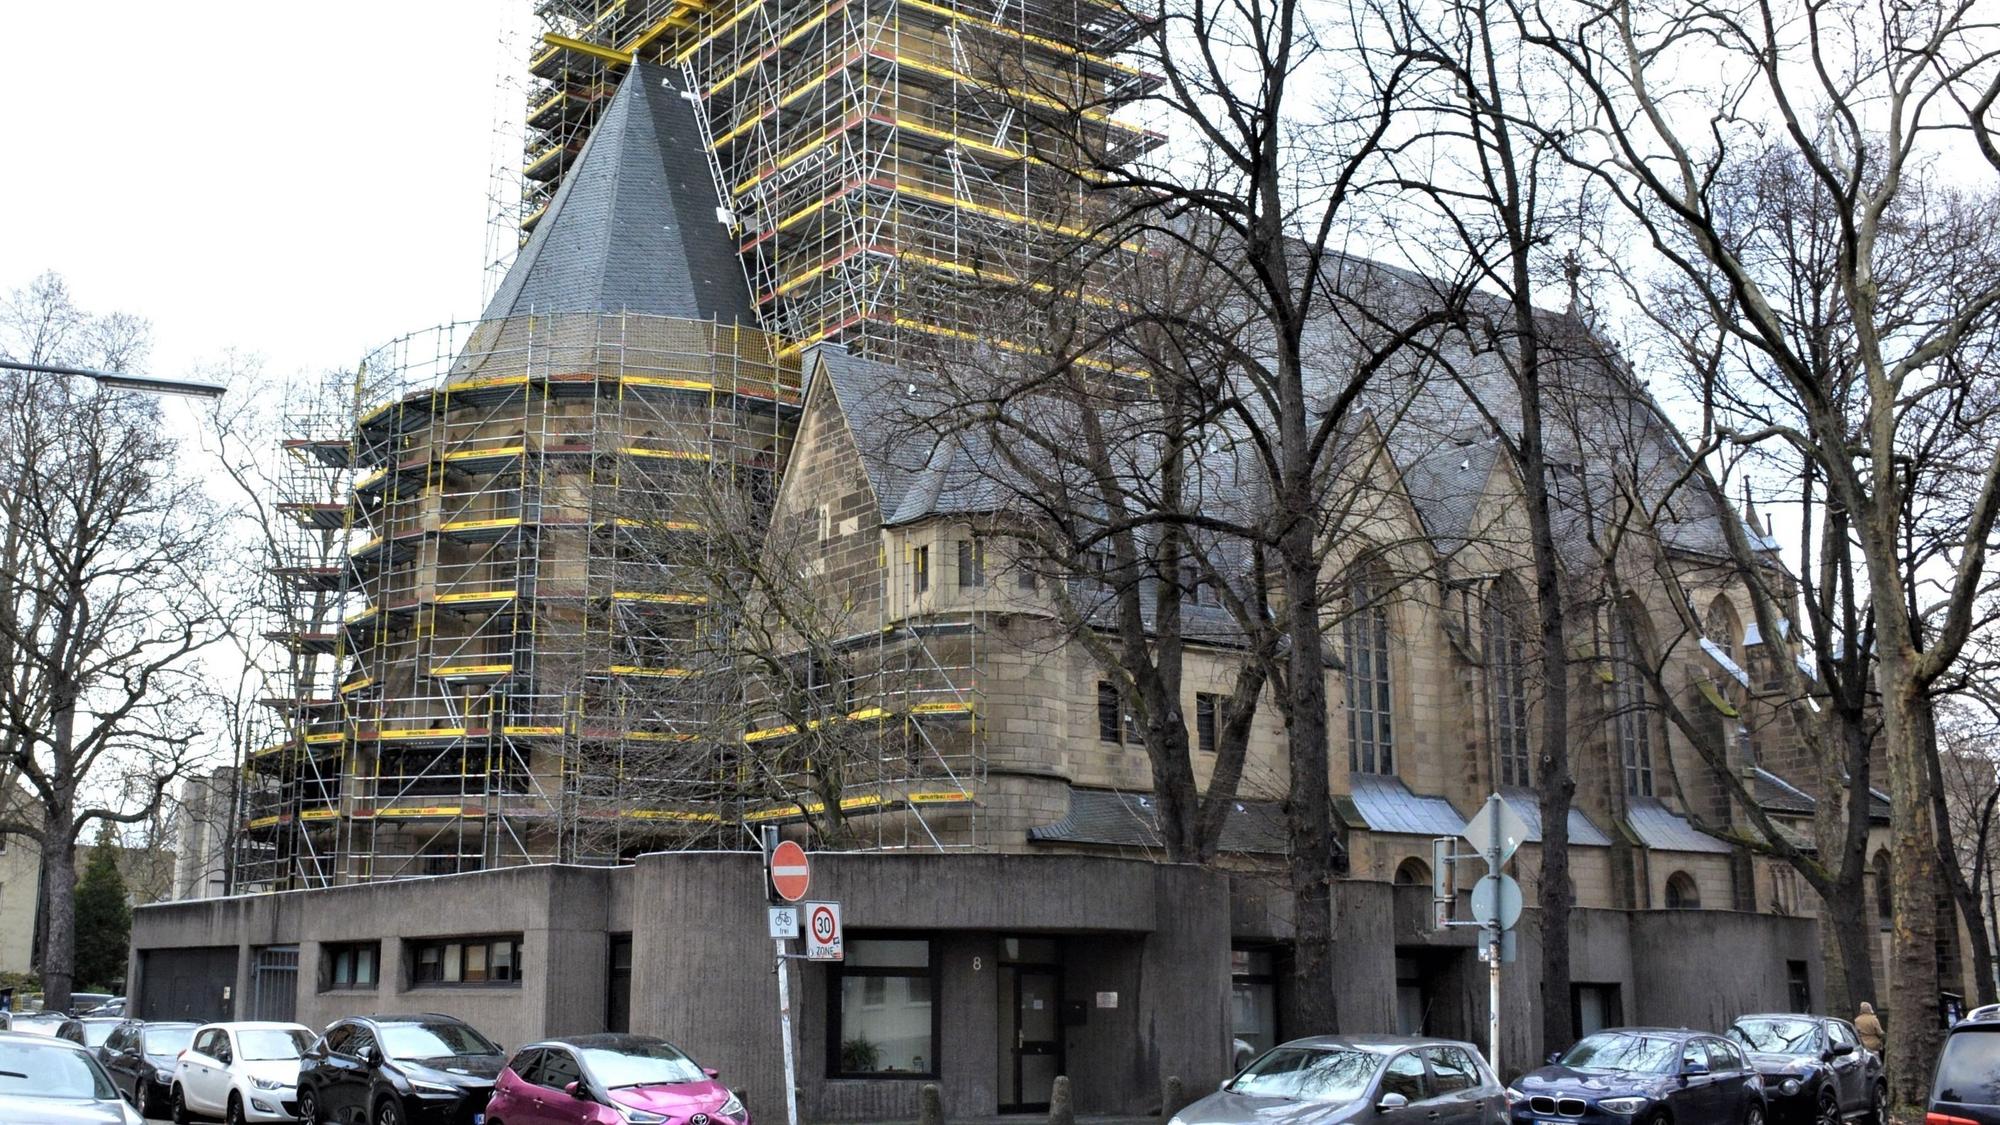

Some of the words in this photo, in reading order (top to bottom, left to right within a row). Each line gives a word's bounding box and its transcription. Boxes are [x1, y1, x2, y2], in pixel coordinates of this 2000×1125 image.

[817, 917, 831, 934] 30
[816, 946, 834, 956] ZONE
[973, 956, 981, 970] 8
